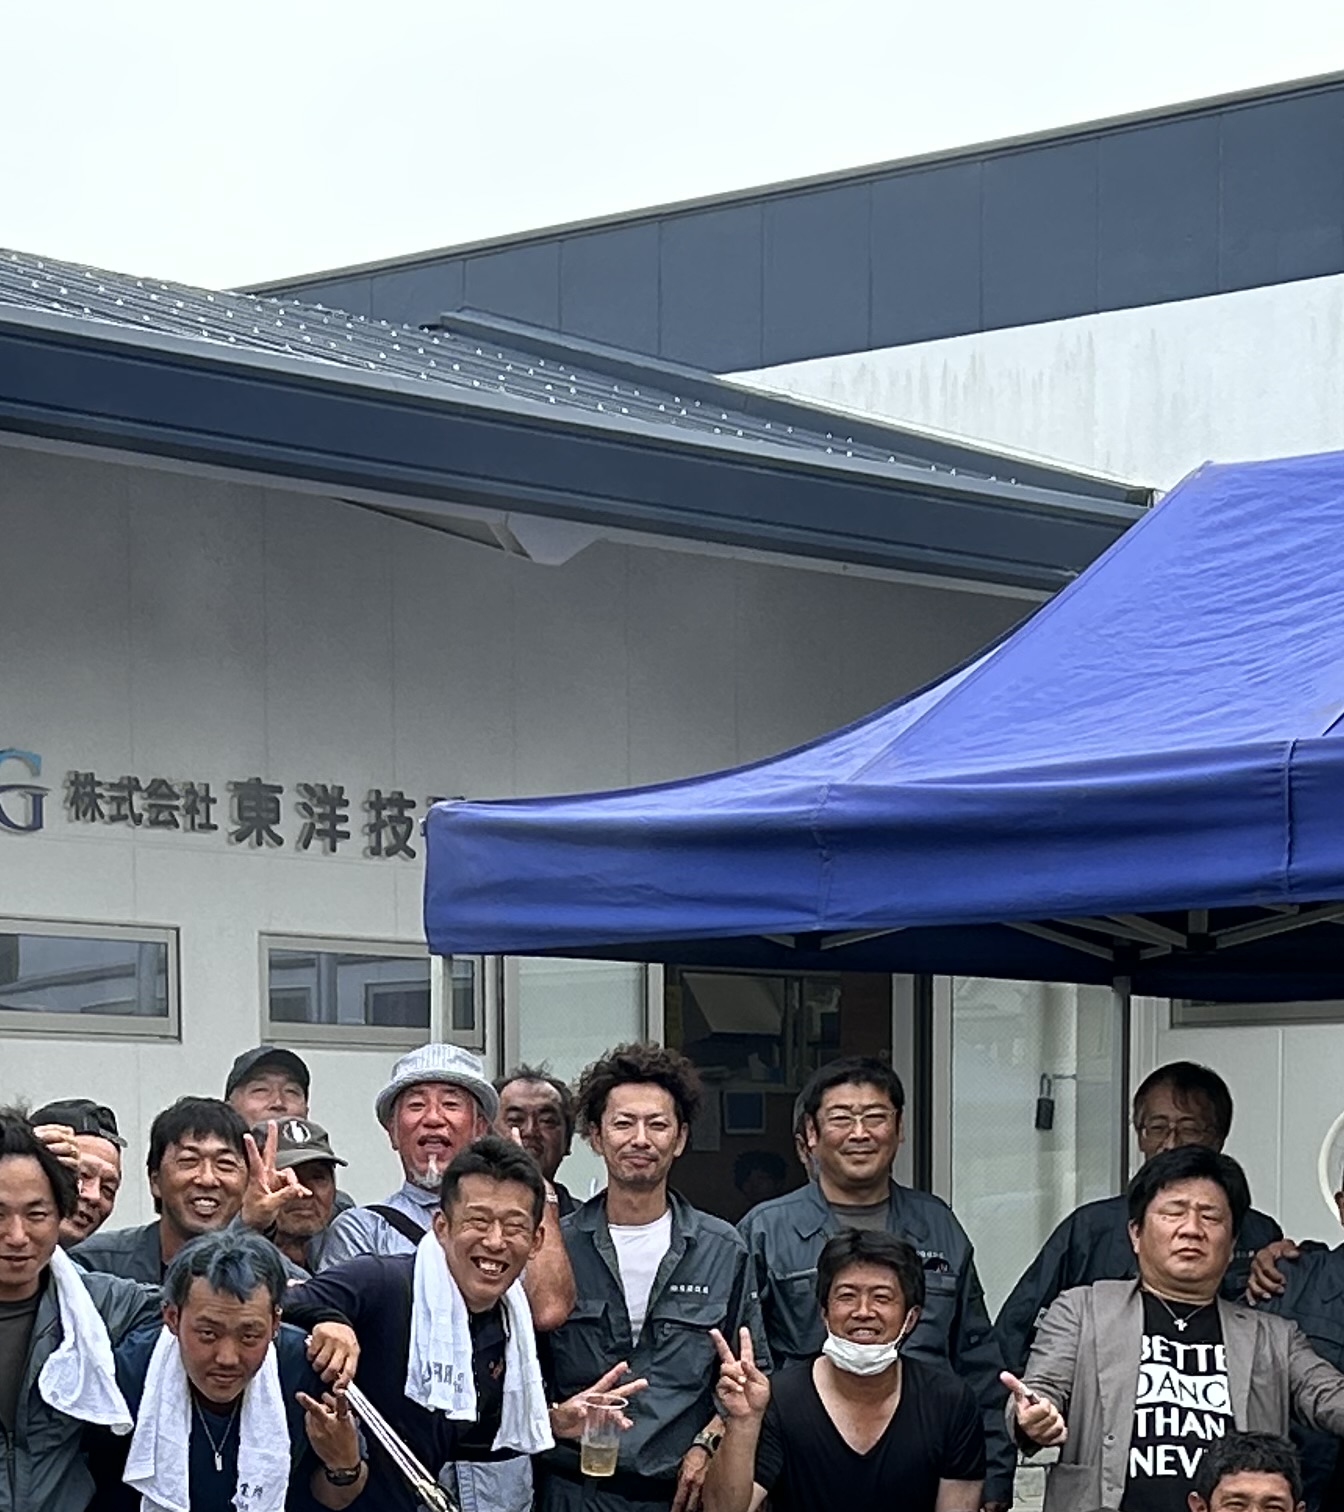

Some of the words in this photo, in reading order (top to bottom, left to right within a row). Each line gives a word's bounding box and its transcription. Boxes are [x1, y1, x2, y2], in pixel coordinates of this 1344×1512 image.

[1141, 1335, 1227, 1373] BETTE
[1137, 1371, 1226, 1408] DANC
[1134, 1406, 1225, 1441] THAN
[1130, 1444, 1209, 1479] NEV
